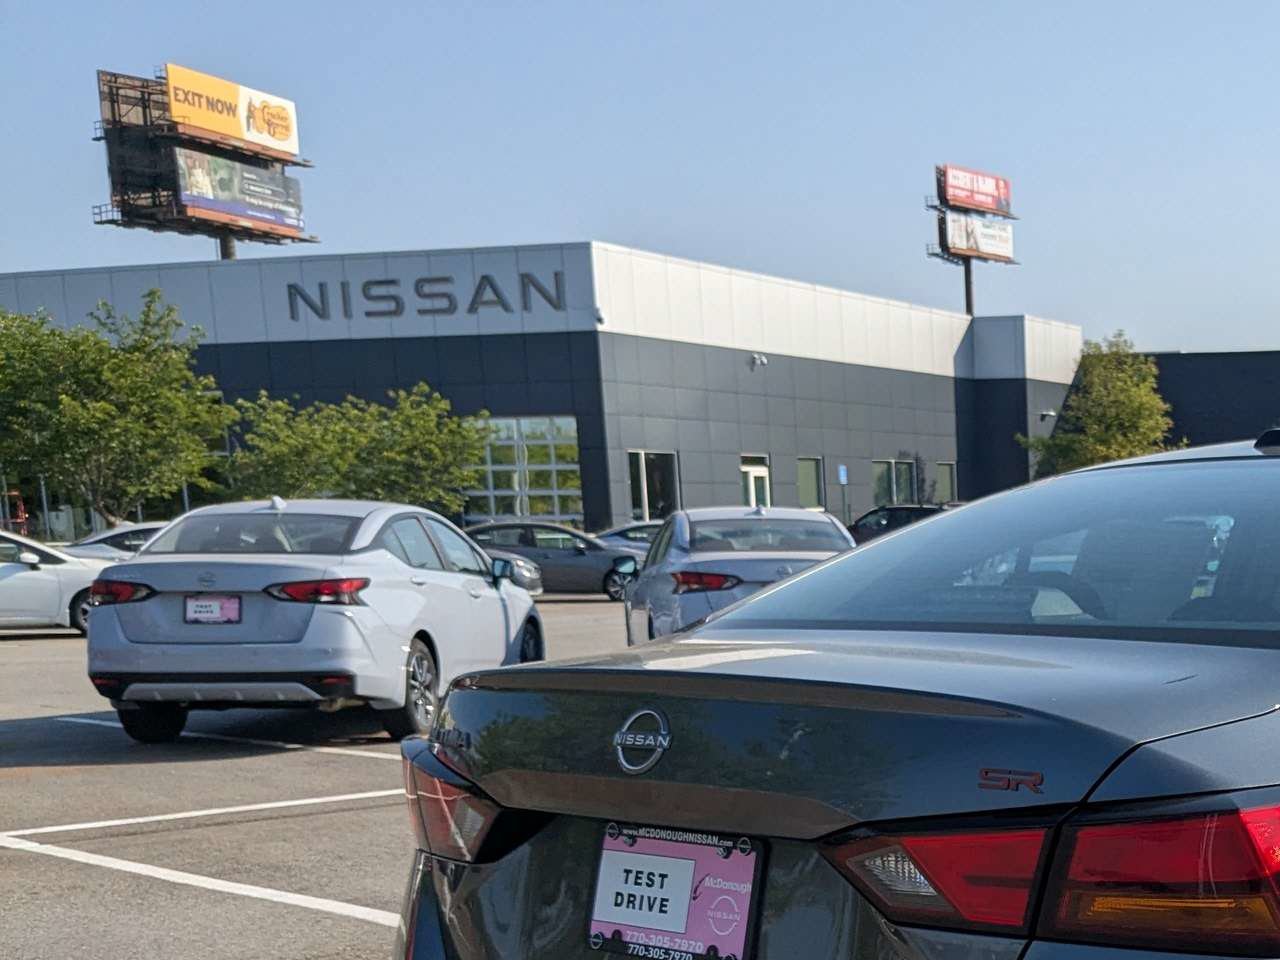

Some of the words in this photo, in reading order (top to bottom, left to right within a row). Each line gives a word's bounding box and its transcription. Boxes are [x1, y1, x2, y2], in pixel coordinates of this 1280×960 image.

[173, 86, 203, 109] EXIT
[205, 95, 237, 118] NOW
[287, 271, 567, 322] NISSAN
[613, 733, 670, 747] NISSAN
[978, 768, 1044, 794] SR
[623, 868, 669, 890] TEST
[614, 891, 670, 914] DRIVE
[626, 930, 704, 953] 770-305-7970
